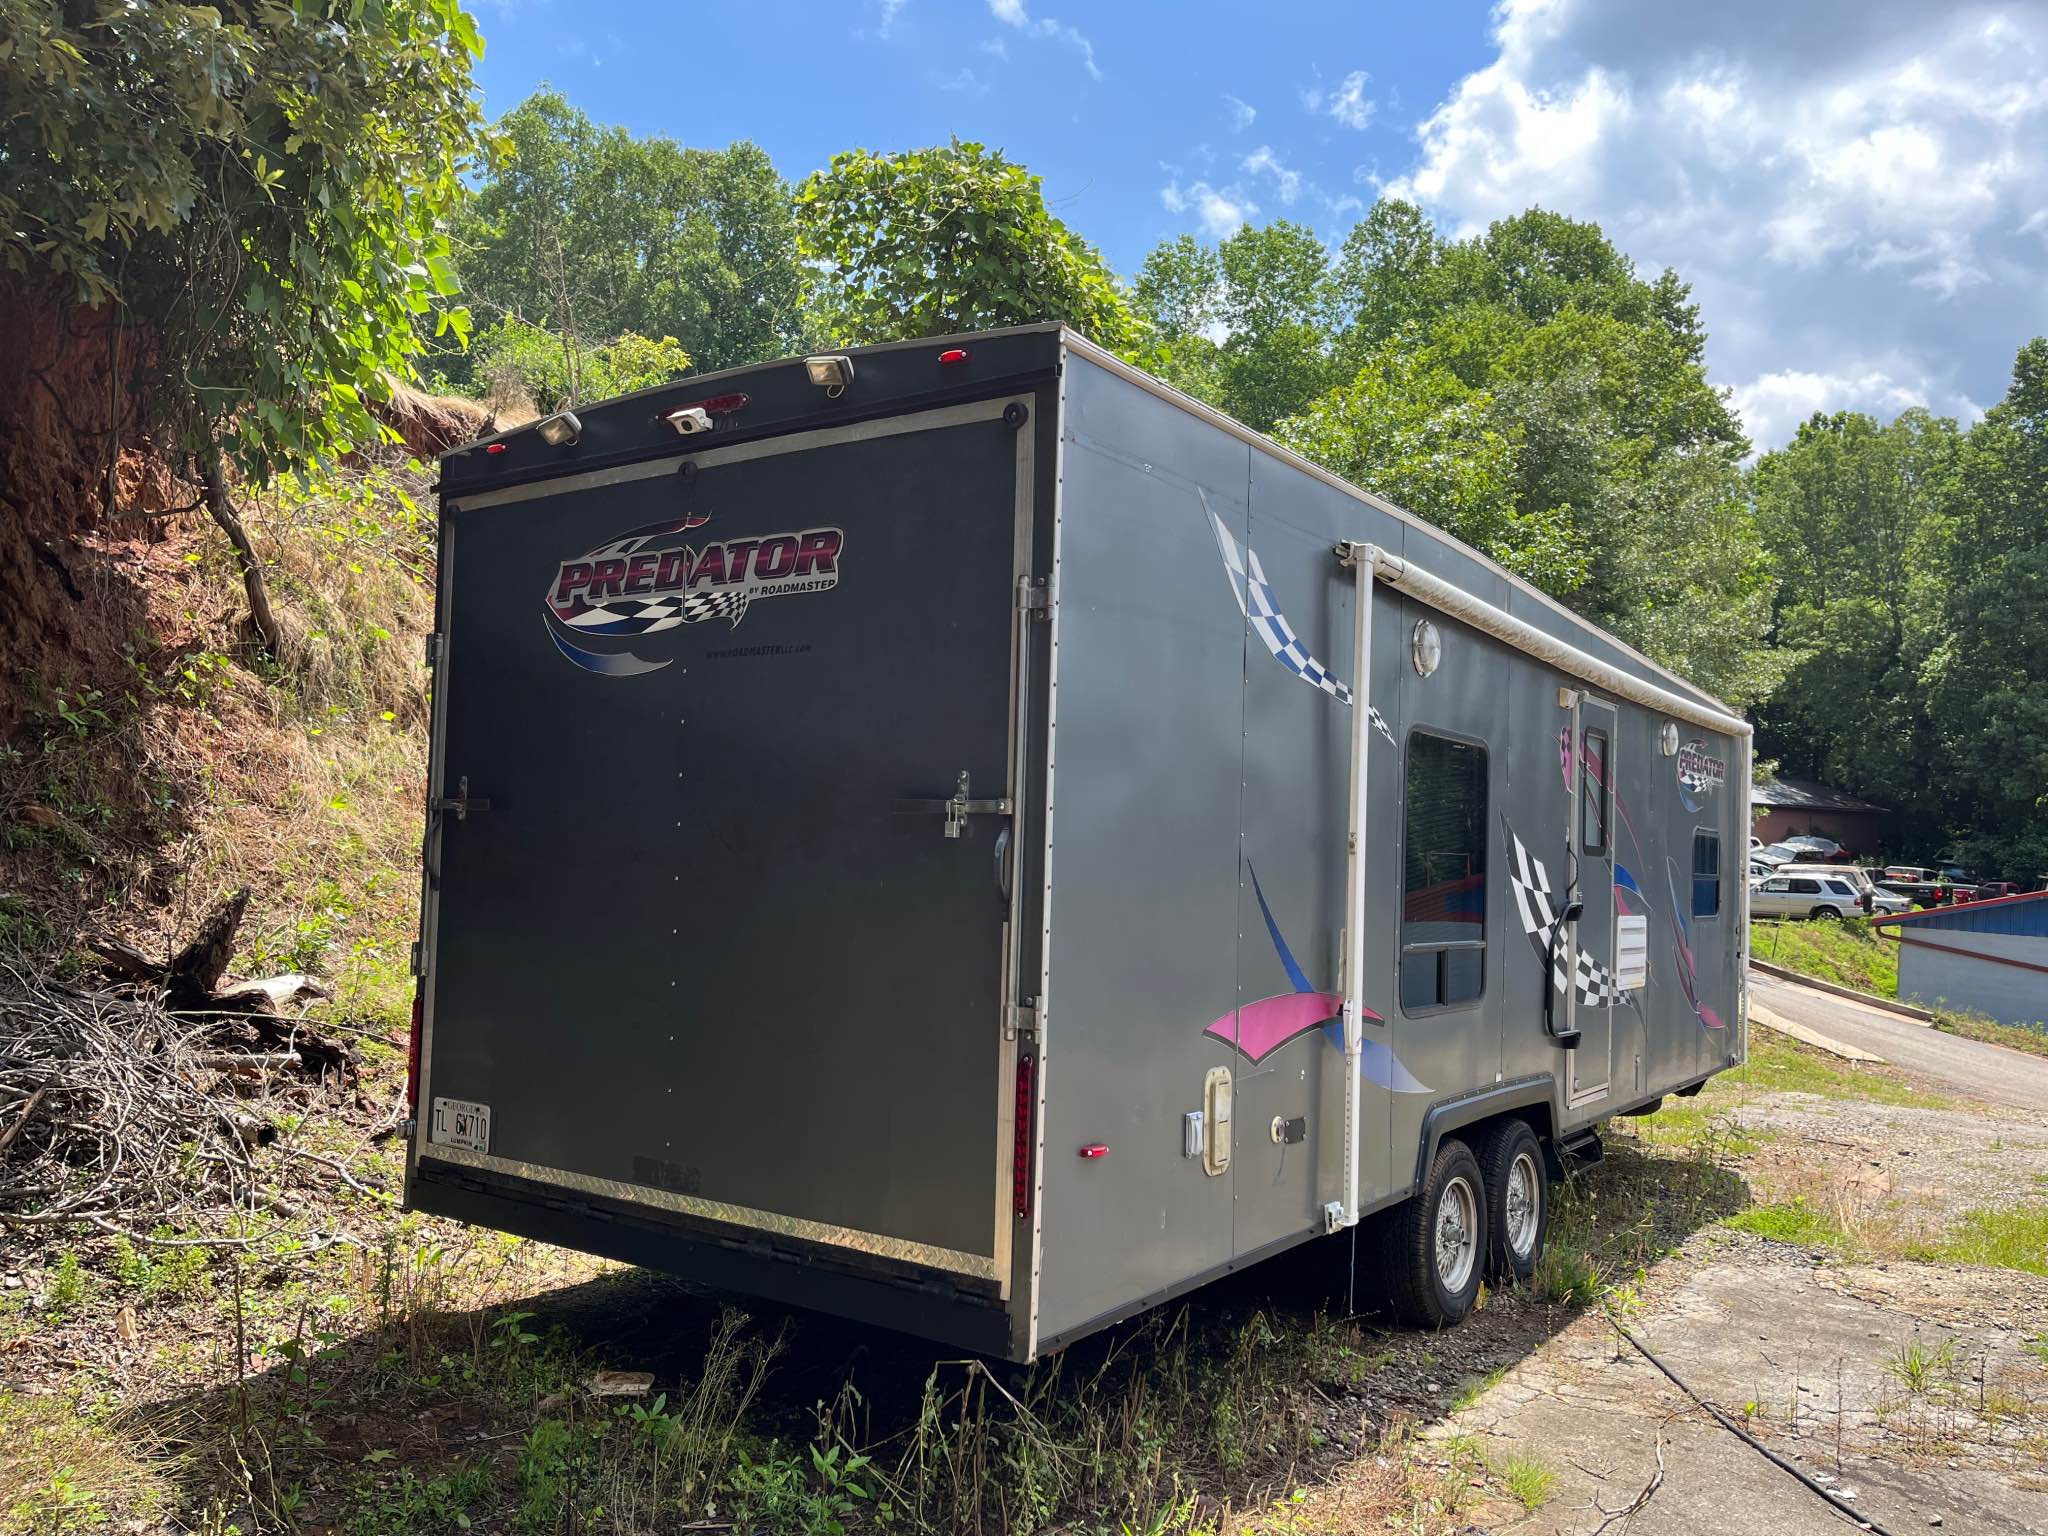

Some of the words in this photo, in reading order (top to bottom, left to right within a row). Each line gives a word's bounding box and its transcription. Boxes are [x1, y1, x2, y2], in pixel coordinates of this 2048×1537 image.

[556, 529, 842, 602] PREDATOR
[749, 587, 759, 595] BY
[760, 579, 836, 596] ROADMASTER
[1679, 749, 1725, 780] PREDATOR
[435, 1109, 447, 1132] TL
[455, 1113, 487, 1140] 6X710
